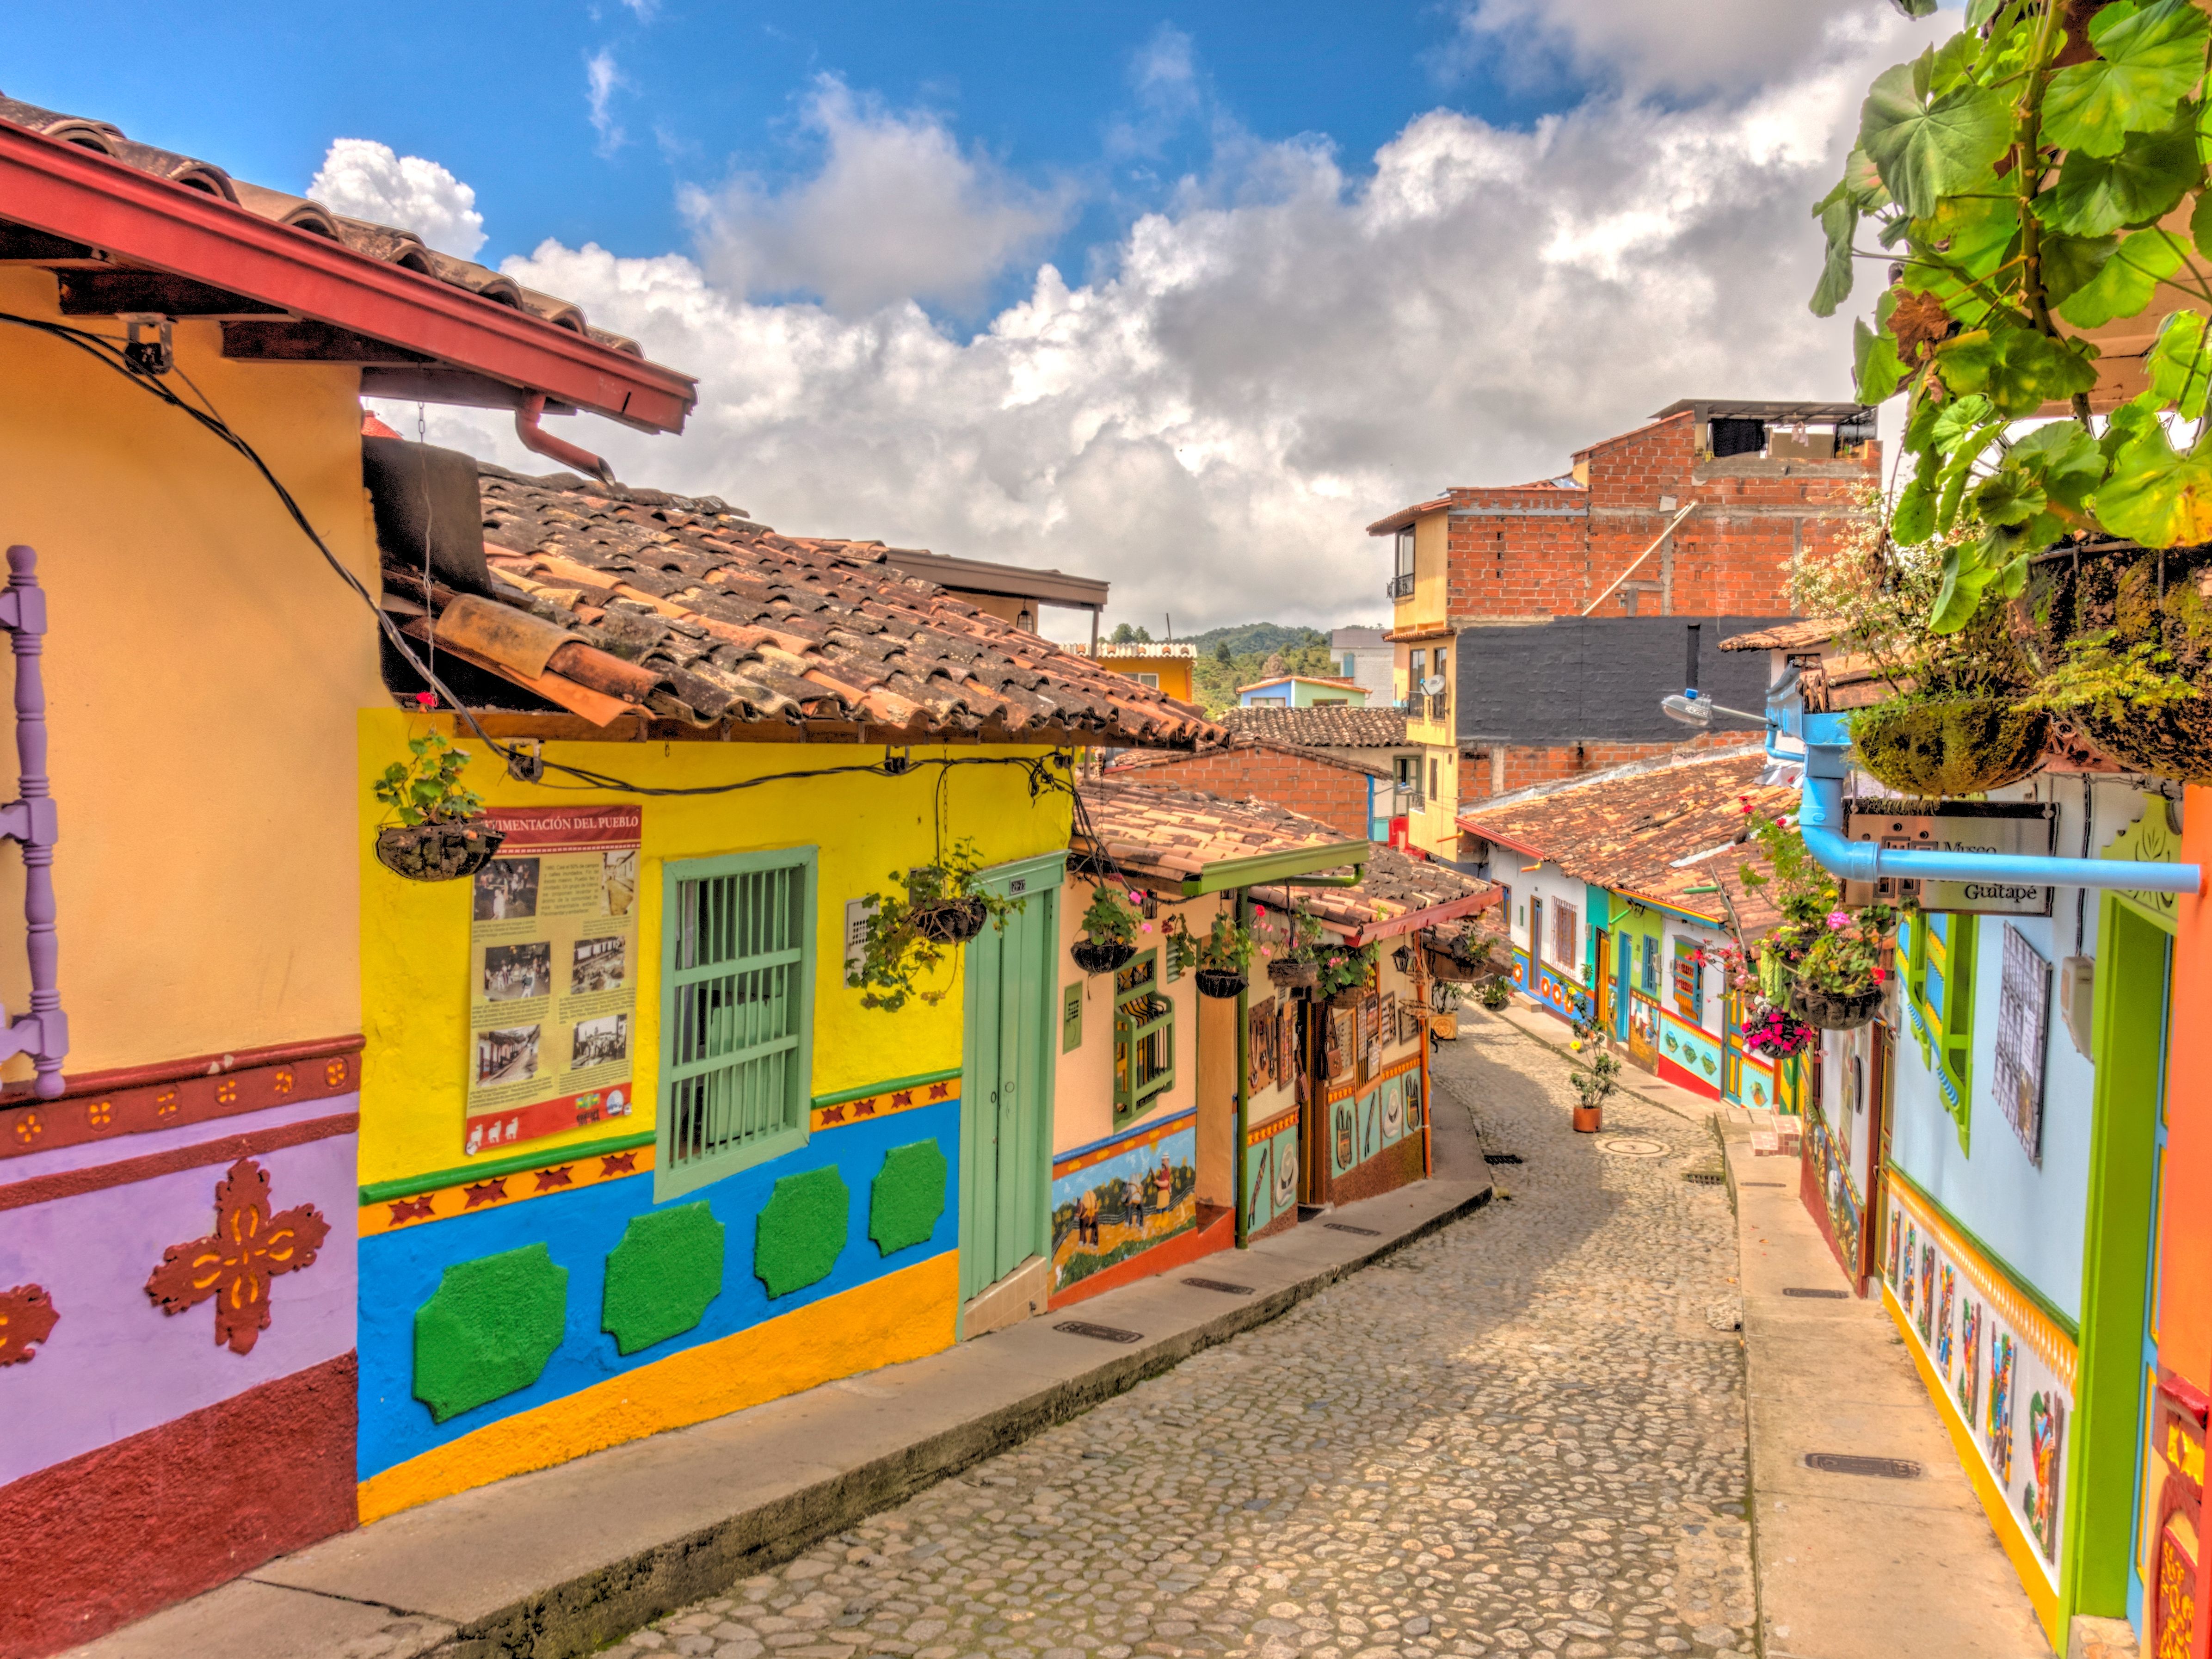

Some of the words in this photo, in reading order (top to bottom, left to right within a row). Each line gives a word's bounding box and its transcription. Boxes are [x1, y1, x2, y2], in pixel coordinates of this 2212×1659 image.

[486, 816, 571, 831] VIMENTACIÓN
[574, 818, 597, 829] DEL
[598, 816, 639, 828] PUEBLO
[1965, 884, 2037, 903] Guatapé
